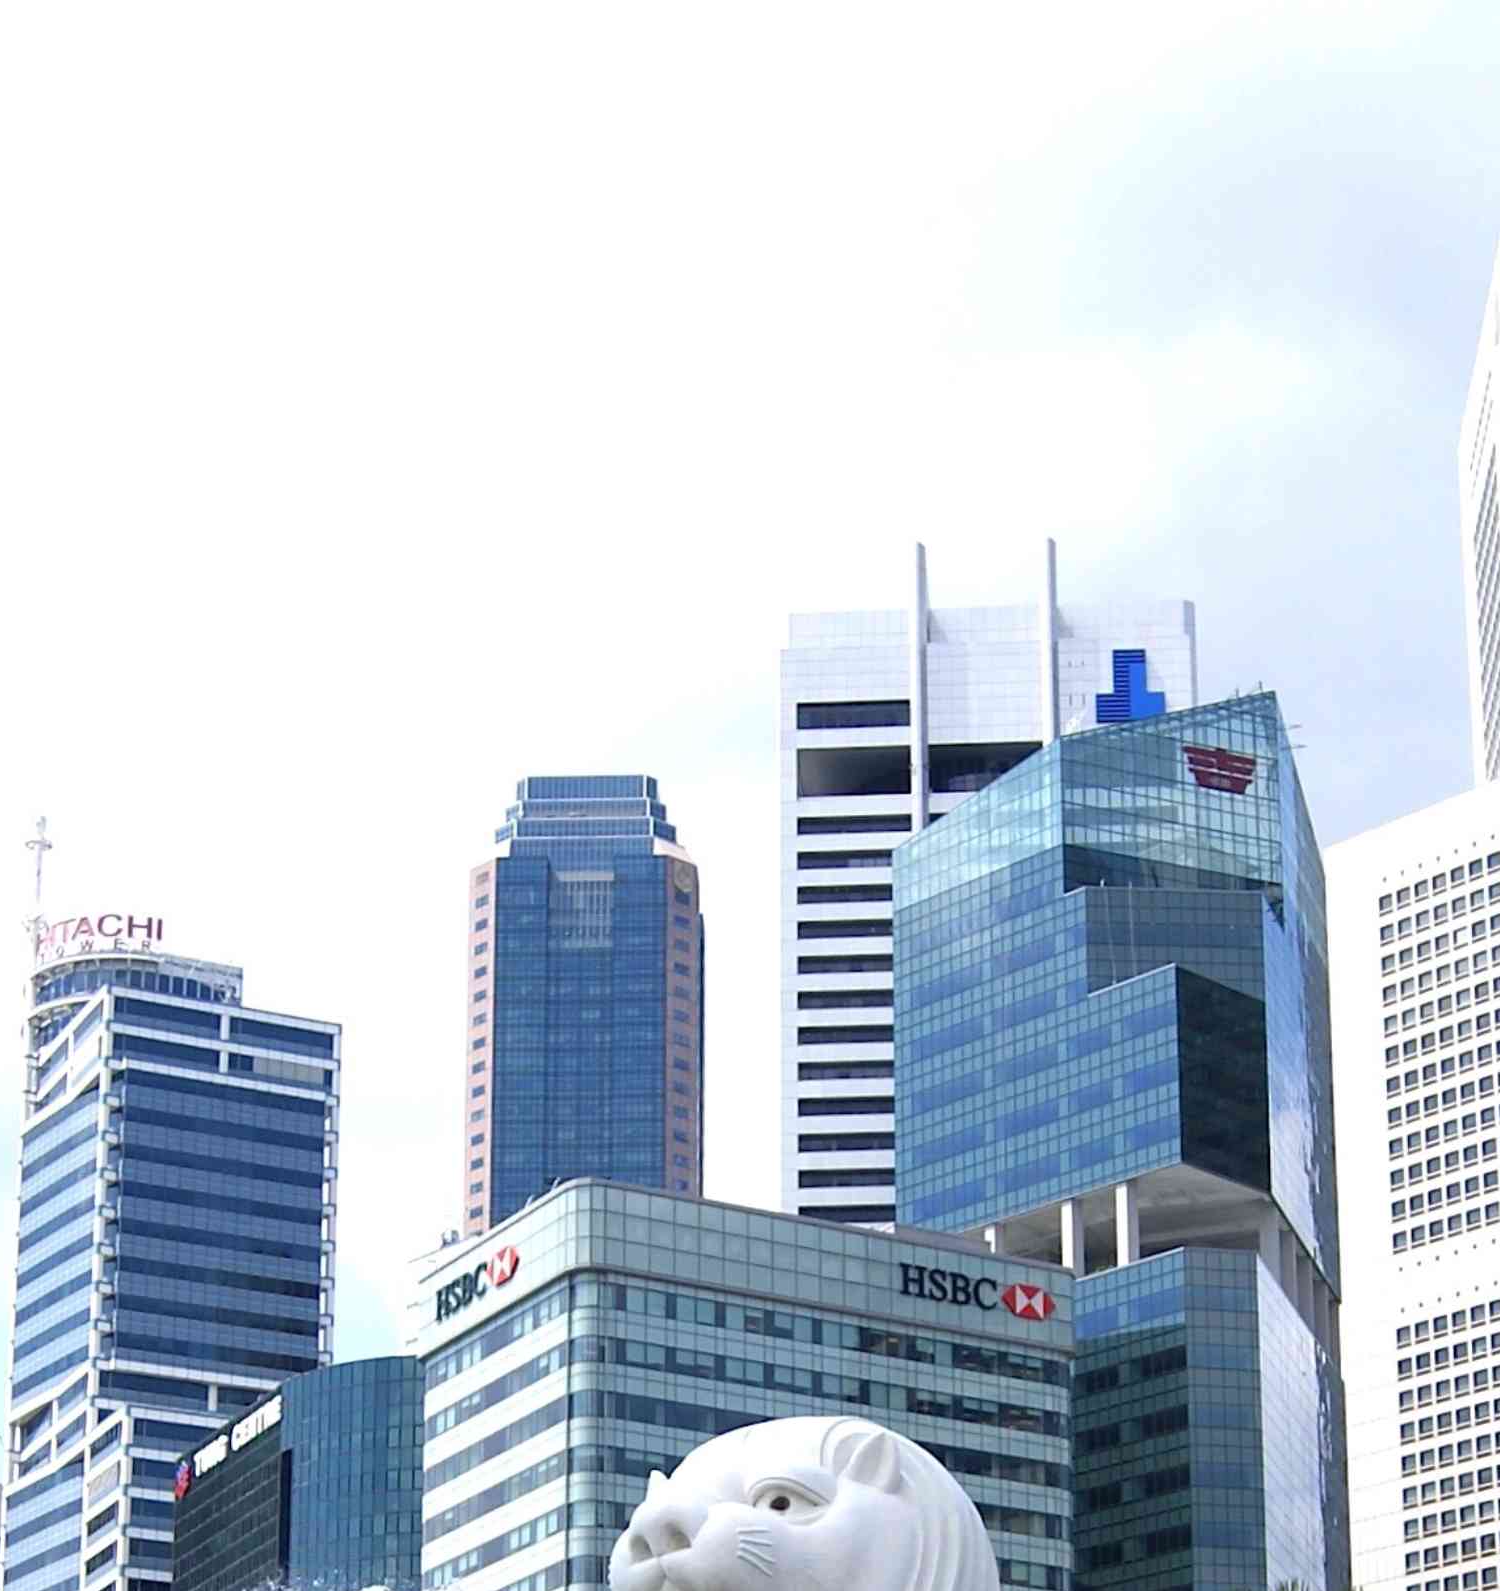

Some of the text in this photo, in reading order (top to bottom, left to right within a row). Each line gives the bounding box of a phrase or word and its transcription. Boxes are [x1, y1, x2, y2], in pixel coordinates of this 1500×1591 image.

[36, 914, 163, 958] HITACHI
[435, 1261, 488, 1324] HSBC
[899, 1262, 998, 1310] HSBC
